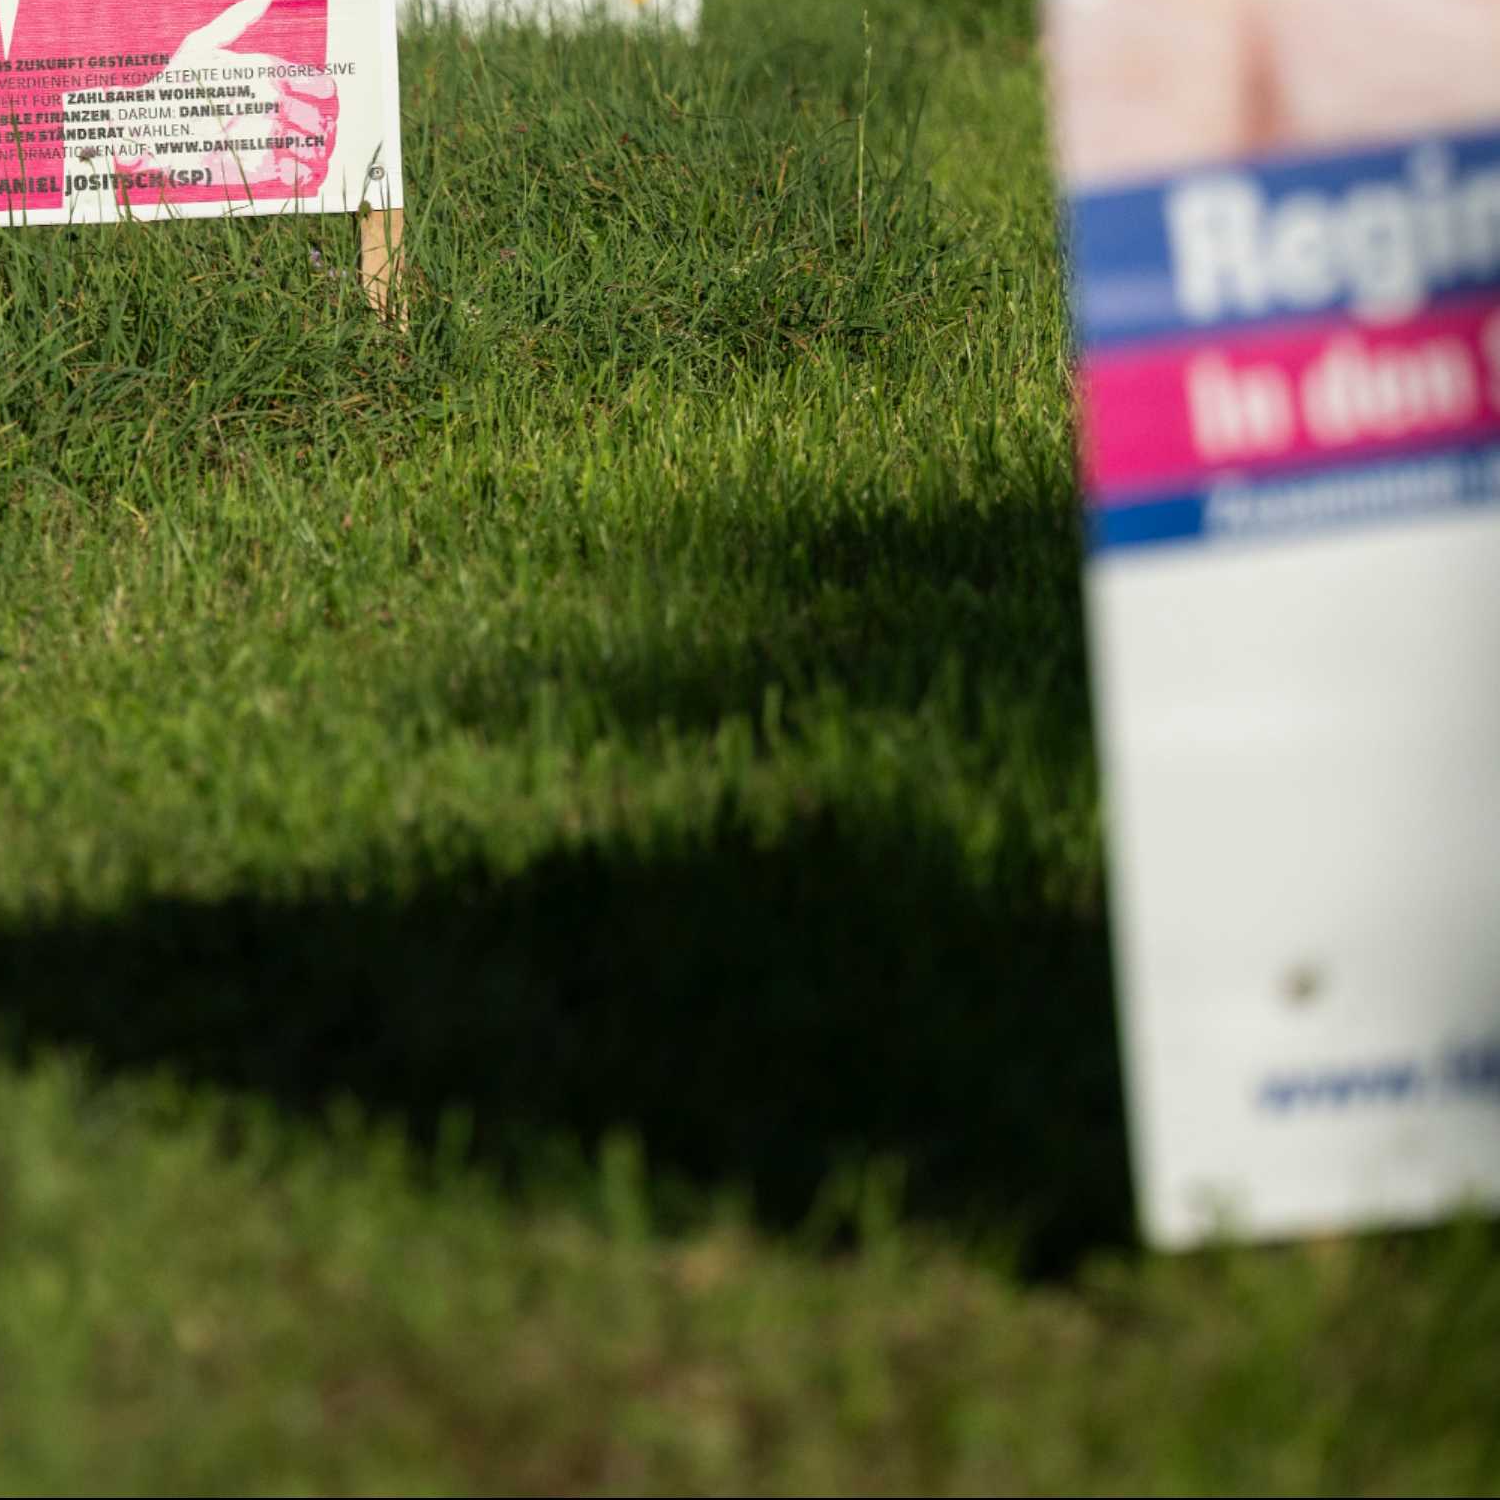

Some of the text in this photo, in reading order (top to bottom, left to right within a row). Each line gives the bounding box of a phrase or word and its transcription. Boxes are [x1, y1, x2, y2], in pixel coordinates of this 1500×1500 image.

[15, 57, 85, 71] ZUKUNFT
[87, 54, 170, 68] GESTALTEN
[85, 73, 121, 87] EINE
[122, 68, 218, 86] KOMPETENTE
[222, 67, 254, 80] UND
[258, 62, 356, 79] PROGRESSIVE
[67, 89, 155, 104] ZAHLBAREN
[158, 85, 256, 100] WOHNRAUM,
[179, 104, 234, 118] DANIEL
[236, 101, 280, 115] LEUPI
[39, 125, 125, 141] STÄNDERAT
[128, 123, 195, 137] WÄHLEN.
[154, 135, 324, 155] WWW.DANIELLEUPI.CH
[169, 167, 213, 188] (SP)
